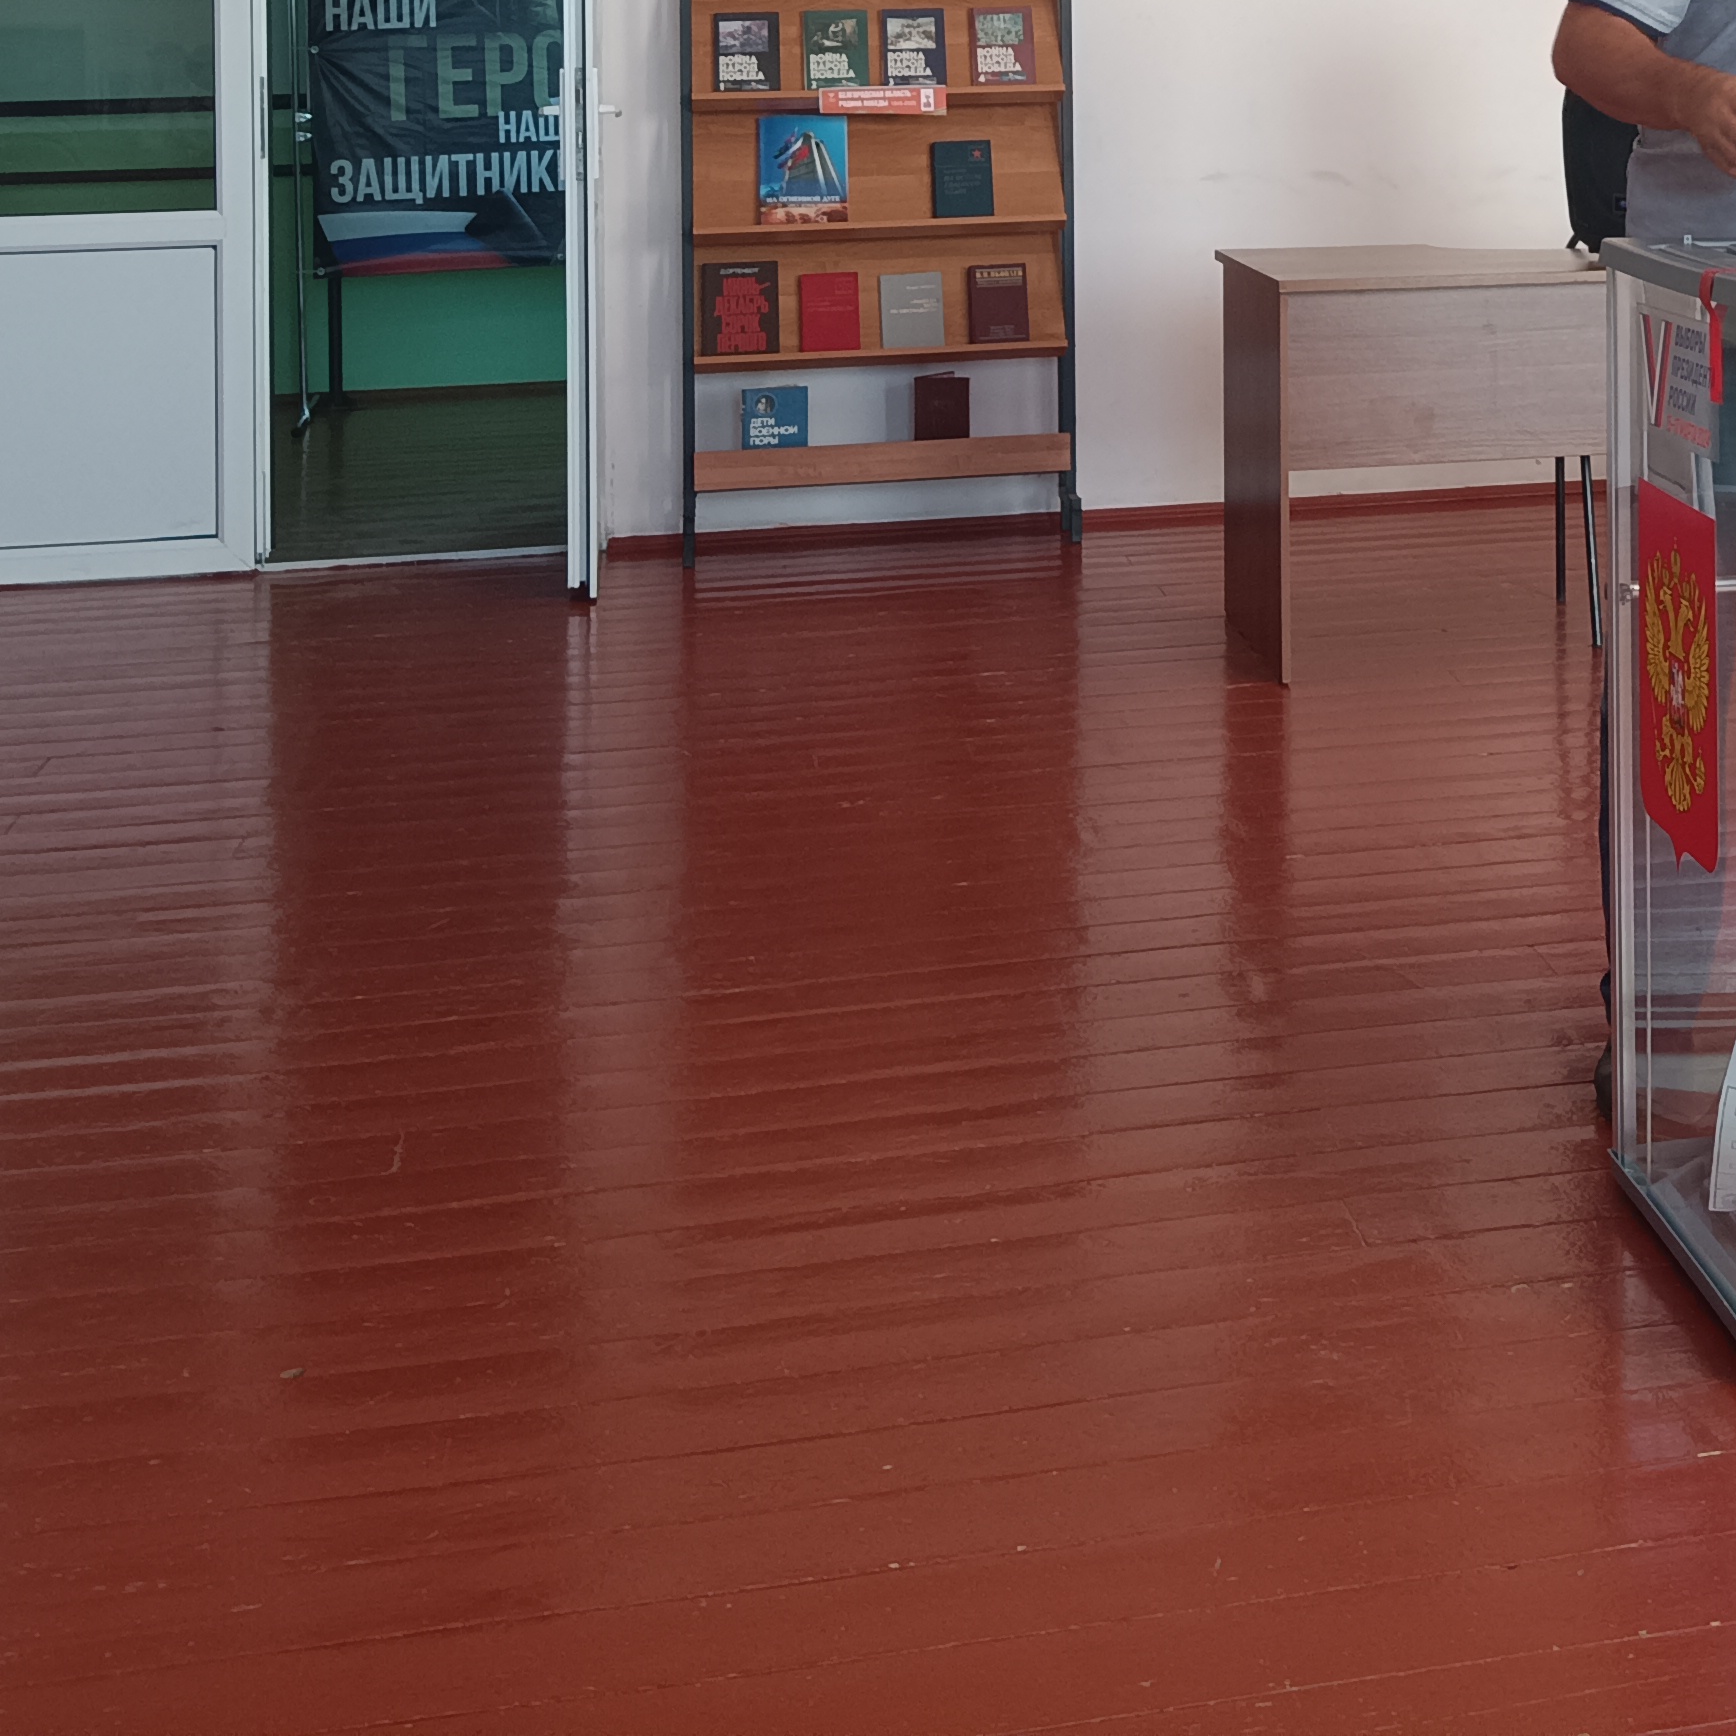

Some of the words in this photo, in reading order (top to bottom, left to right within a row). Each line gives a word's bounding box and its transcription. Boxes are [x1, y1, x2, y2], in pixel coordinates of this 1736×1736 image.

[386, 29, 562, 122] ГЕРО
[498, 110, 561, 143] НАШ
[1674, 324, 1707, 355] ВЫБОРЫ
[1671, 354, 1712, 388] ПРЕЗИДЕНТ
[750, 417, 775, 427] ДЕТИ
